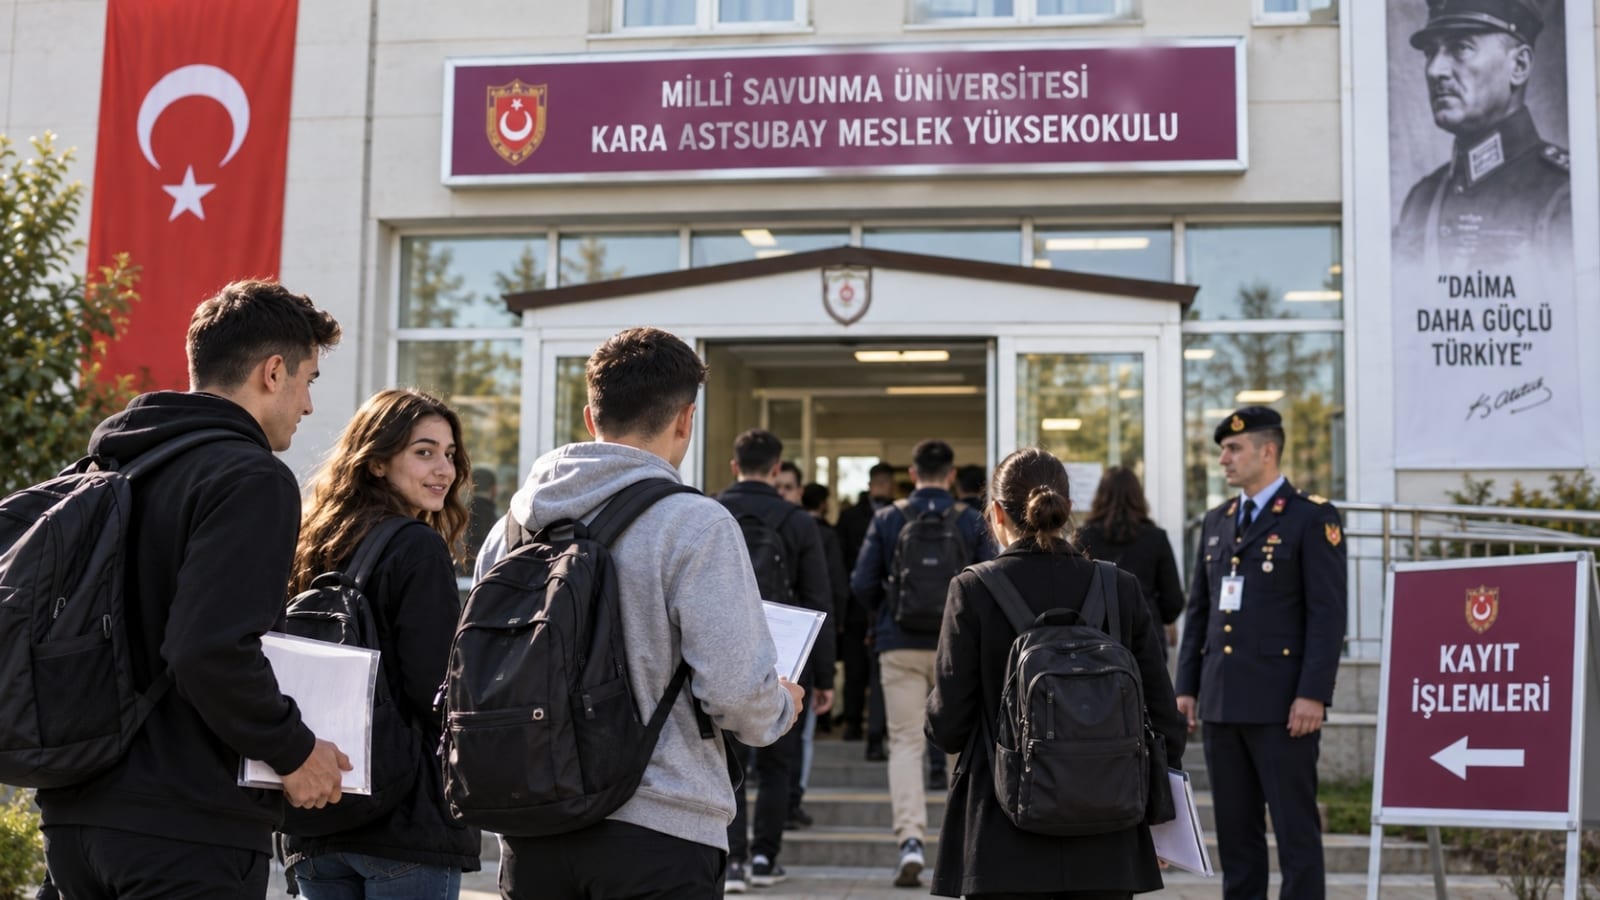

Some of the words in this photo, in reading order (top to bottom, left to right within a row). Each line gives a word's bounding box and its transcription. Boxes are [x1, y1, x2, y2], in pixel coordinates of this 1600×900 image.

[661, 71, 733, 109] MİLLÎ
[743, 74, 883, 106] SAVUNMA
[894, 64, 1089, 102] ÜNİVERSİTESİ
[591, 123, 668, 153] KARA
[678, 119, 828, 151] ASTSUBAY
[838, 117, 953, 147] MESLEK
[963, 109, 1179, 144] YÜKSEKOKULU
[1416, 309, 1475, 333] DAHA
[1482, 303, 1553, 338] GÜÇLÜ
[1439, 642, 1520, 673] KAYIT
[1411, 675, 1550, 720] İŞLEMLERİ
